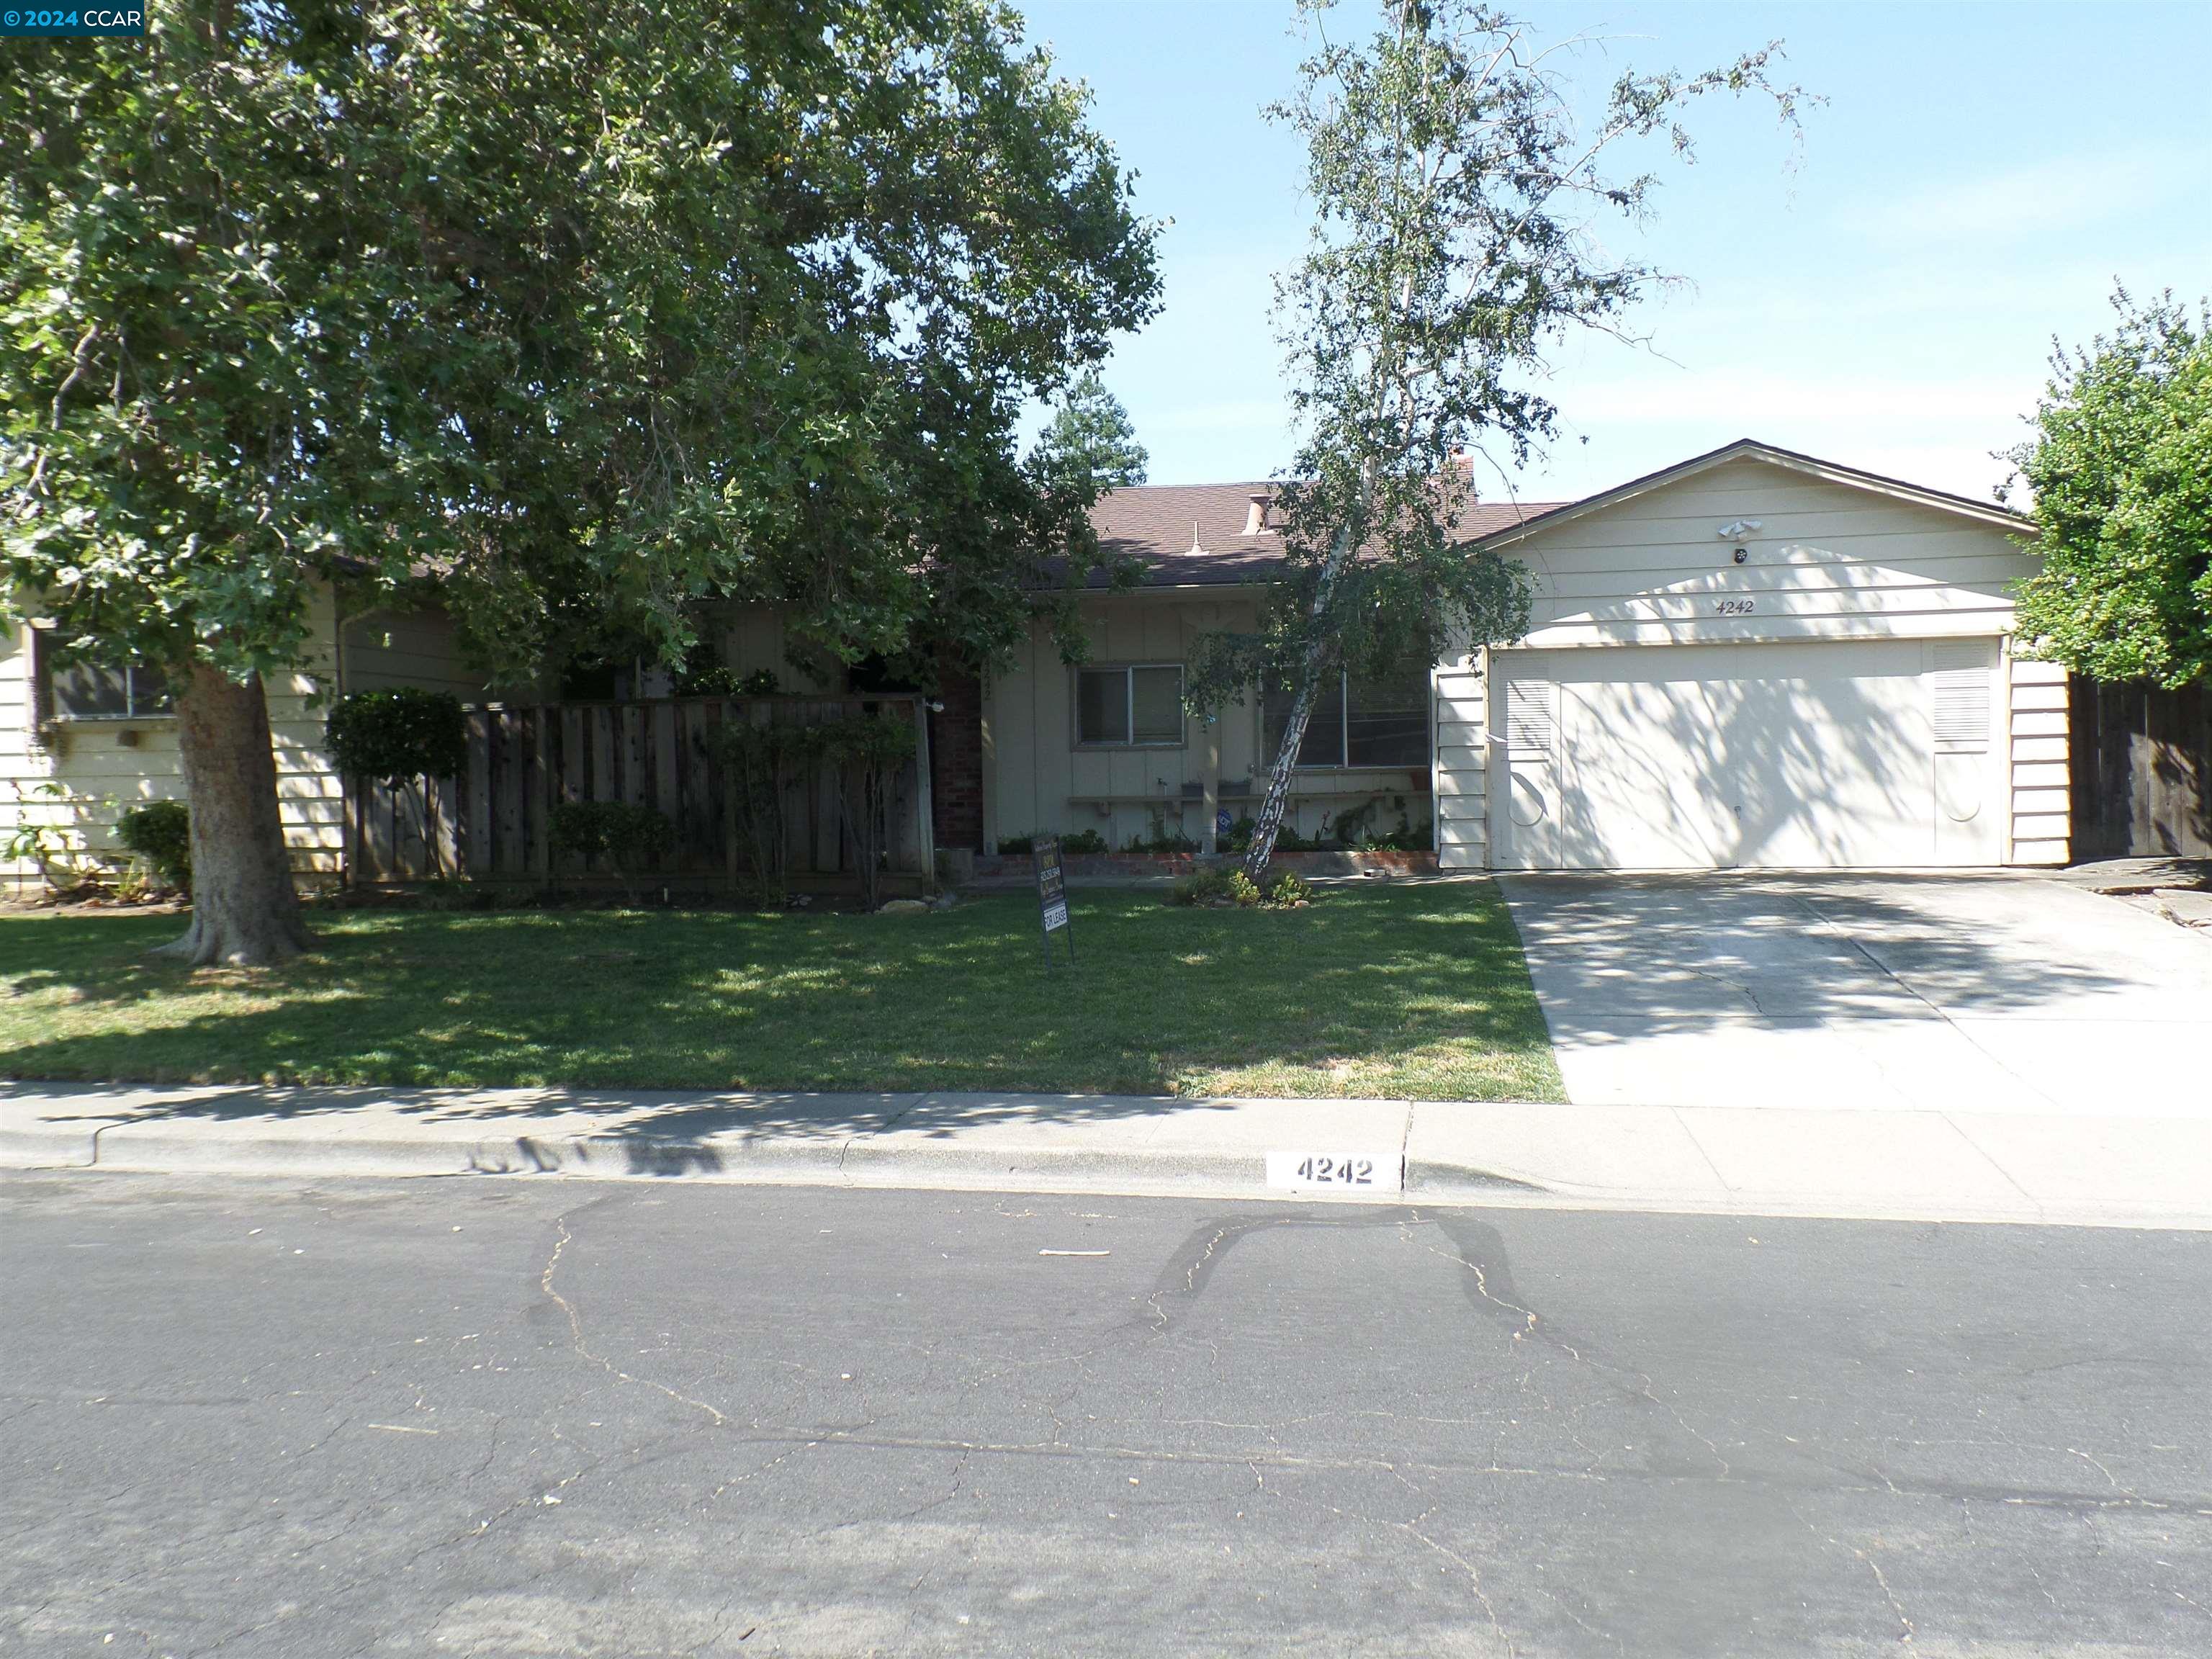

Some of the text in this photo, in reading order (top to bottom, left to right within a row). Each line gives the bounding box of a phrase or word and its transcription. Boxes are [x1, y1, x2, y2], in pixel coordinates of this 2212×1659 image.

[1716, 601, 1755, 614] 4242
[1053, 909, 1066, 924] LEASE
[1298, 1157, 1372, 1184] 4242
